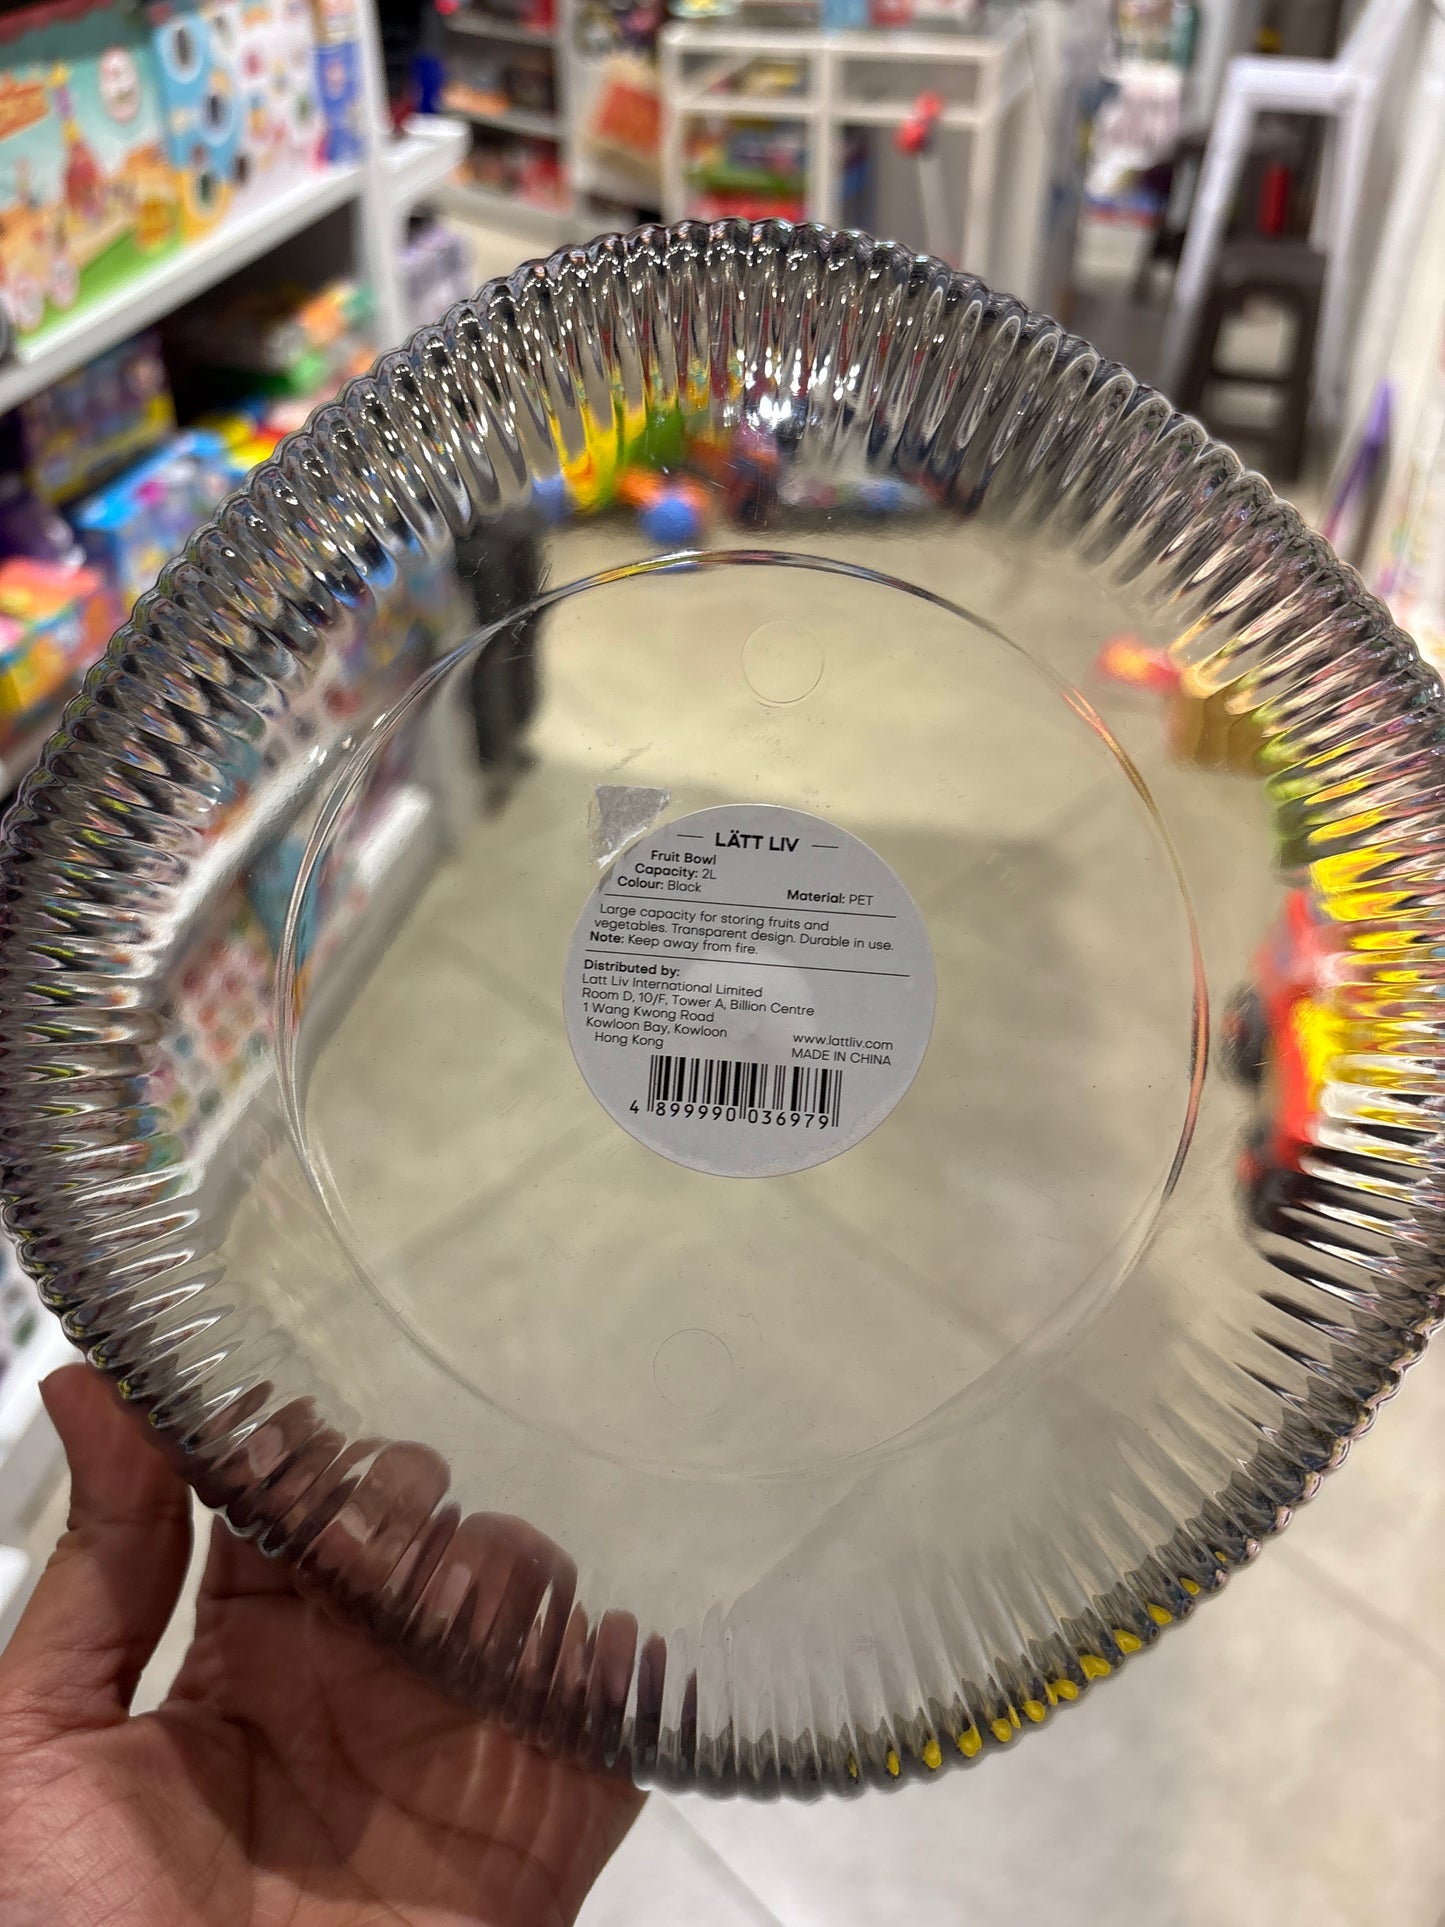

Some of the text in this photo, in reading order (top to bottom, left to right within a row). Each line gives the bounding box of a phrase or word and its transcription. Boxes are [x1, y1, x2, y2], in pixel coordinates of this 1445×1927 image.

[715, 829, 800, 852] LÄTT LIV
[651, 849, 717, 865] Fruit Bowl
[634, 862, 717, 881] Capacity: 2L
[617, 875, 701, 893] Colour: Black
[787, 889, 874, 906] Material: PET
[600, 903, 829, 932] Large capacity for storing fruits and
[589, 931, 758, 955] Note: Keep away from fire.
[594, 919, 894, 951] vegetables. Transparent design. Durable in use.
[584, 959, 680, 979] Distributed by:
[582, 973, 763, 998] Latt Liv International Limited
[582, 987, 815, 1016] Room D, 10/F, Tower A, Billion Centre
[583, 1002, 715, 1023] 1 Wang Kwong Road
[586, 1016, 727, 1037] Kowloon Bay, Kowloon
[594, 1031, 664, 1050] Hong Kong
[793, 1035, 893, 1050] www.lattliv.com
[791, 1048, 891, 1066] MADE IN CHINA
[629, 1099, 829, 1130] 4 899990 036979
